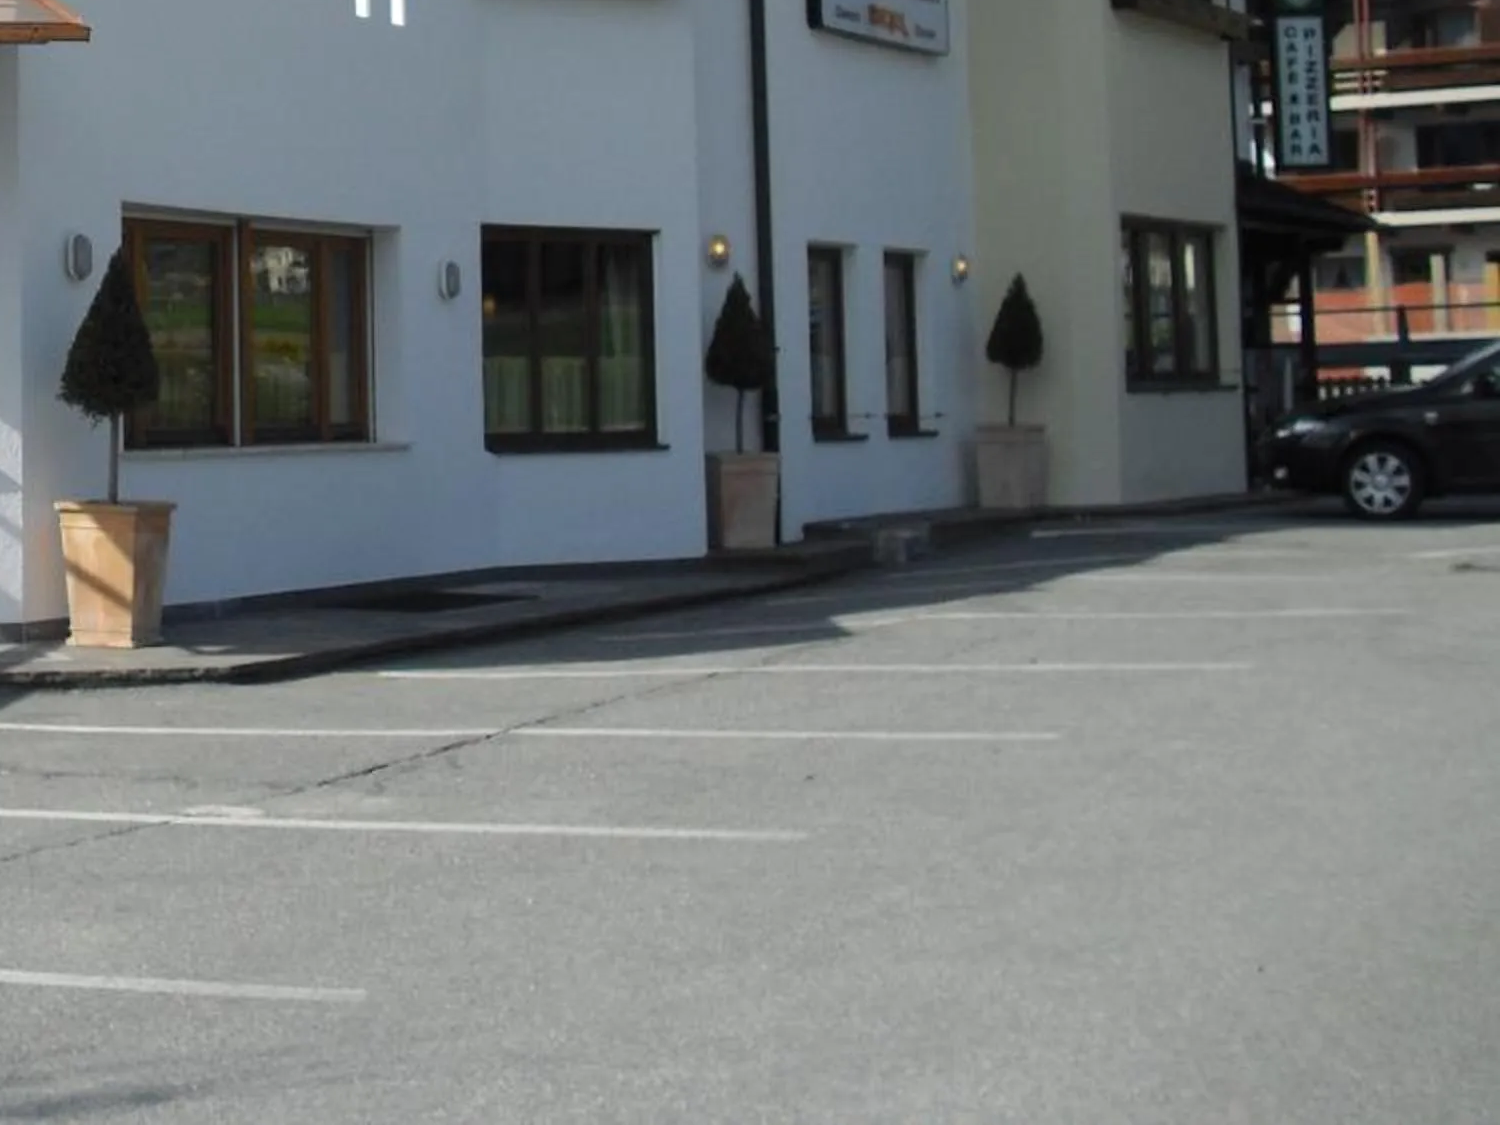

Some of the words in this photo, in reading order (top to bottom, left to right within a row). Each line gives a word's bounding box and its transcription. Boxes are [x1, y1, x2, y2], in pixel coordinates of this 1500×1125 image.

[1284, 26, 1298, 85] CAFE
[1303, 27, 1319, 155] PIZZERIA
[1289, 113, 1302, 155] BAR
